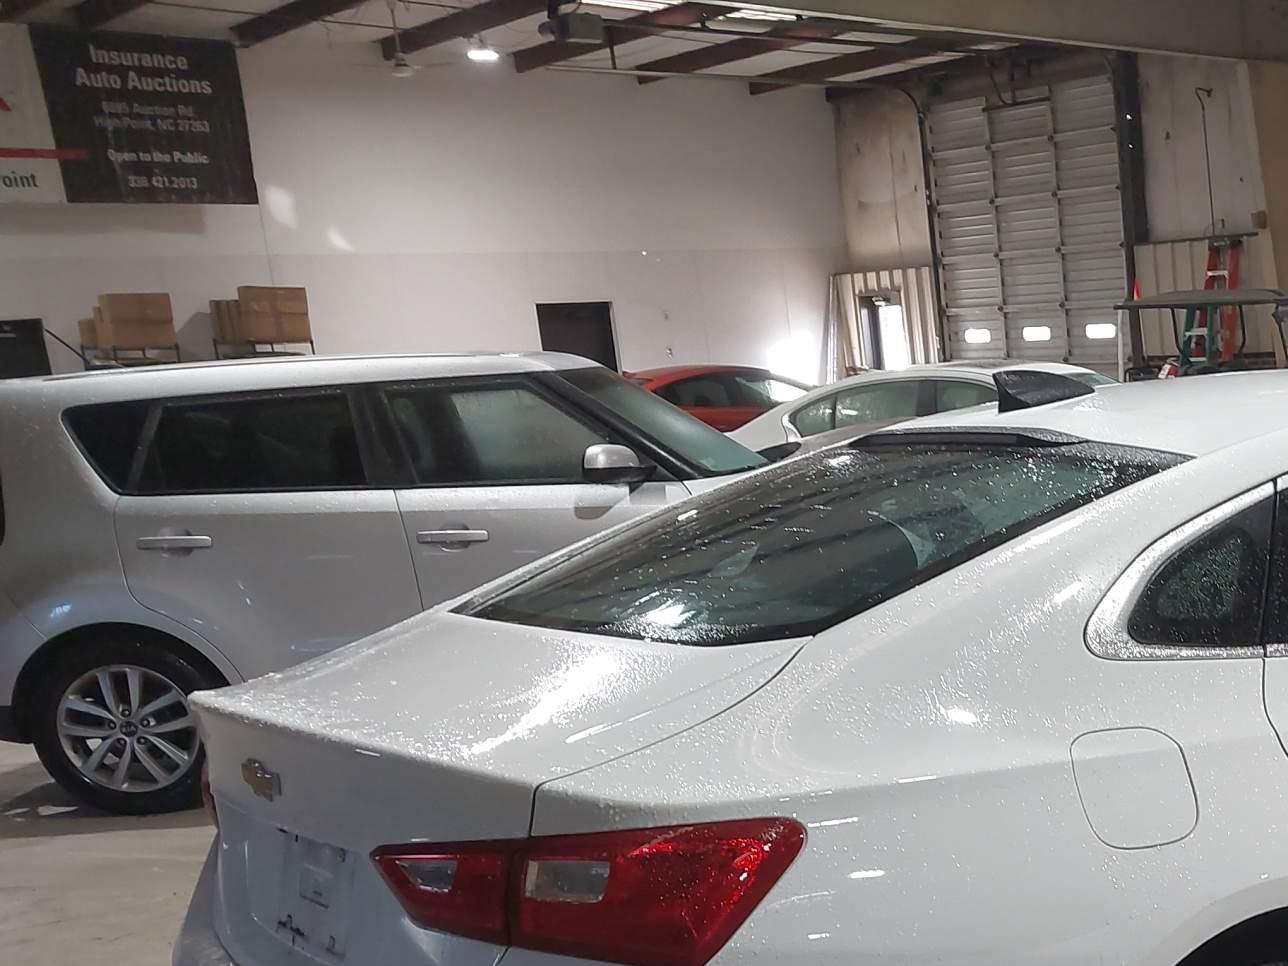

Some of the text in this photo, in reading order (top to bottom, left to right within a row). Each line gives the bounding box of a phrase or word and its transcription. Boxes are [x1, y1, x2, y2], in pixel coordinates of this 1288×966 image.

[89, 44, 188, 70] Insurance
[75, 68, 213, 94] Auto Auctions
[107, 149, 209, 163] Open to the Public
[0, 168, 39, 188] oint
